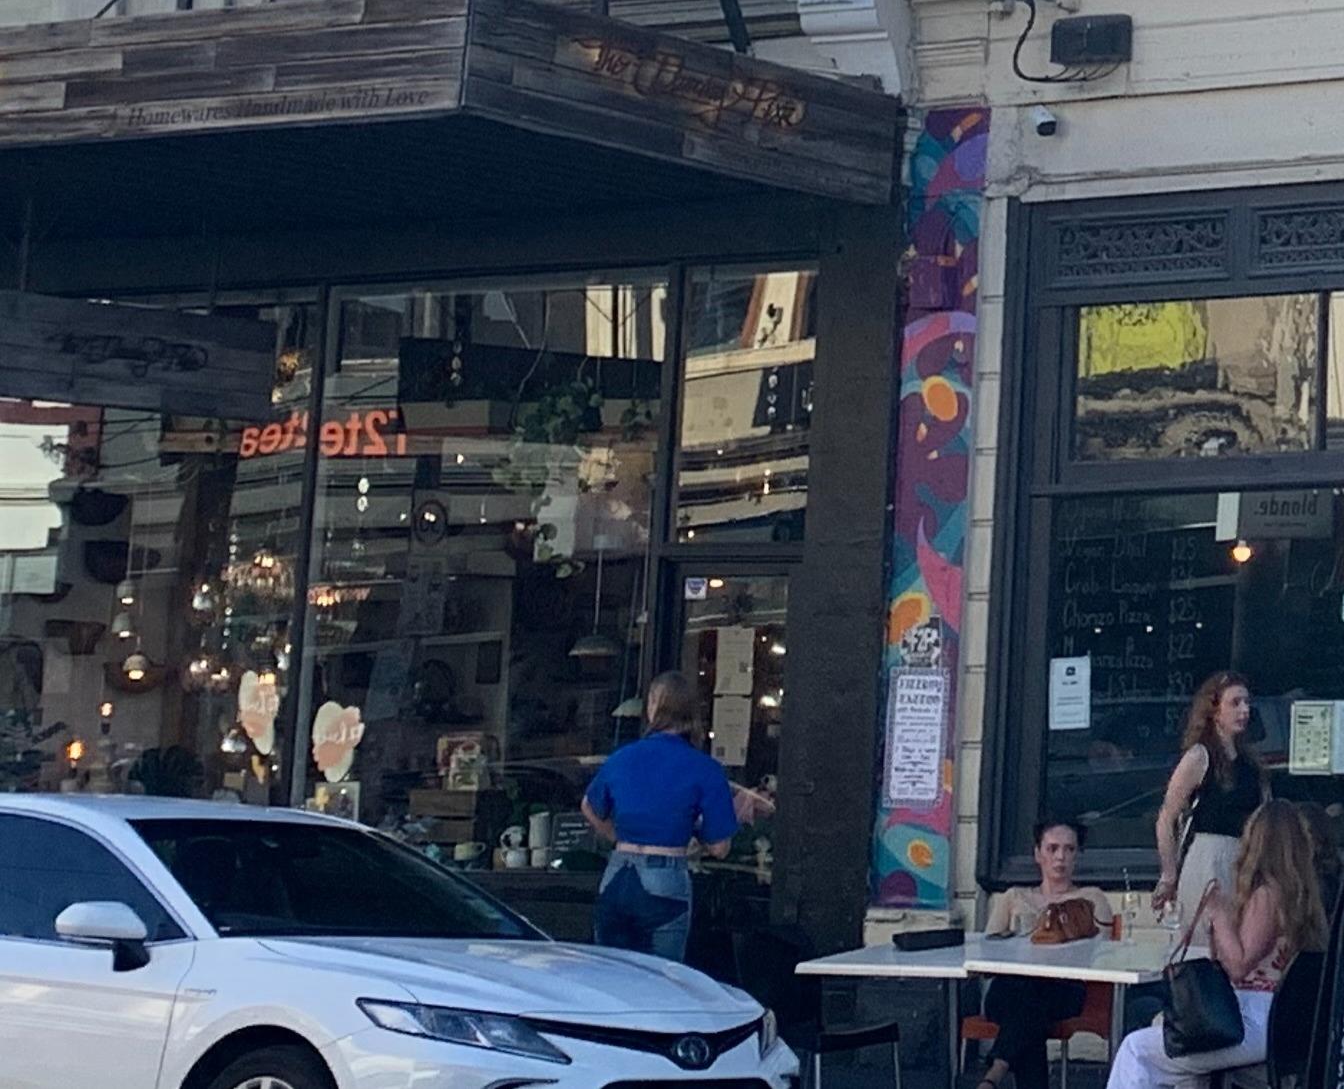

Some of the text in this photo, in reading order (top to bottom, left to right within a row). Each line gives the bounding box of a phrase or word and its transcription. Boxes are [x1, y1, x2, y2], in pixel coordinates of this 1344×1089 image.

[127, 86, 430, 127] Homewares Handmade with Love
